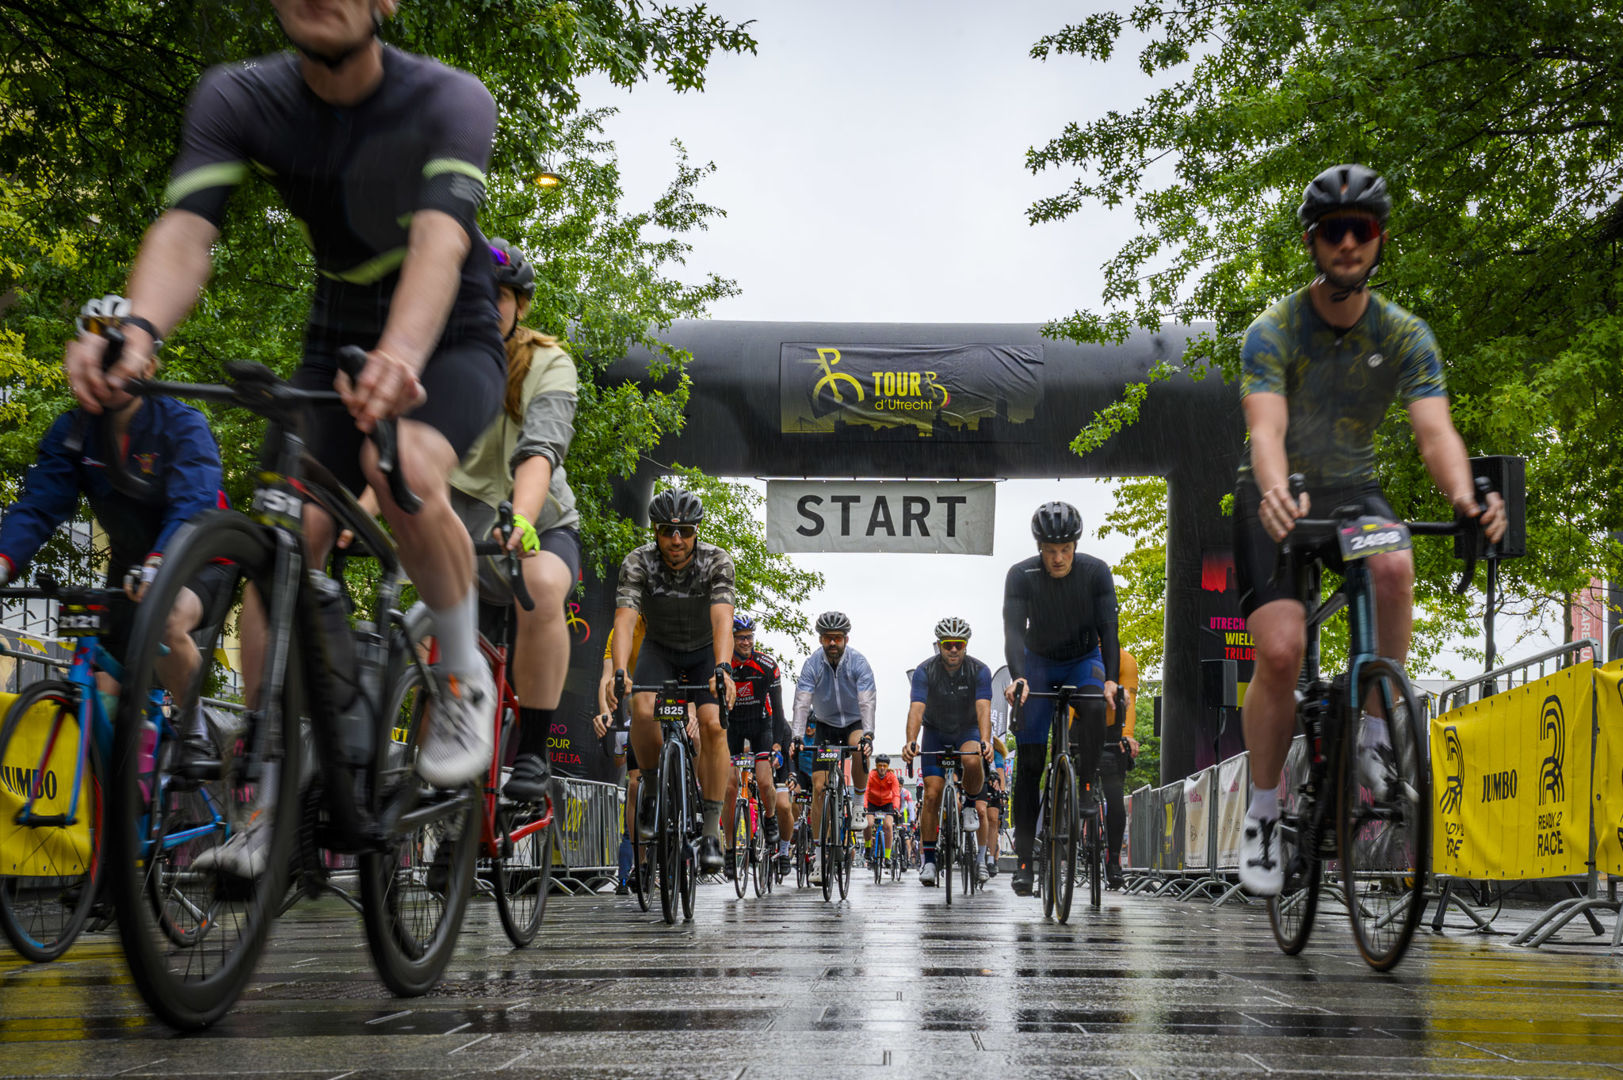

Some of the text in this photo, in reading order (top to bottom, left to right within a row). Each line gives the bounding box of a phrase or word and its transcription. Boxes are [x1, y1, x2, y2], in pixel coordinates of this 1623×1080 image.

[872, 371, 922, 397] TOUR
[874, 399, 934, 411] d'Utrecht
[795, 494, 967, 537] START
[1210, 616, 1246, 630] UTRECH
[658, 706, 684, 715] 1825
[546, 737, 570, 750] OUR
[1481, 768, 1518, 803] JUMBO
[1556, 811, 1563, 827] 2
[1537, 831, 1564, 858] RACE
